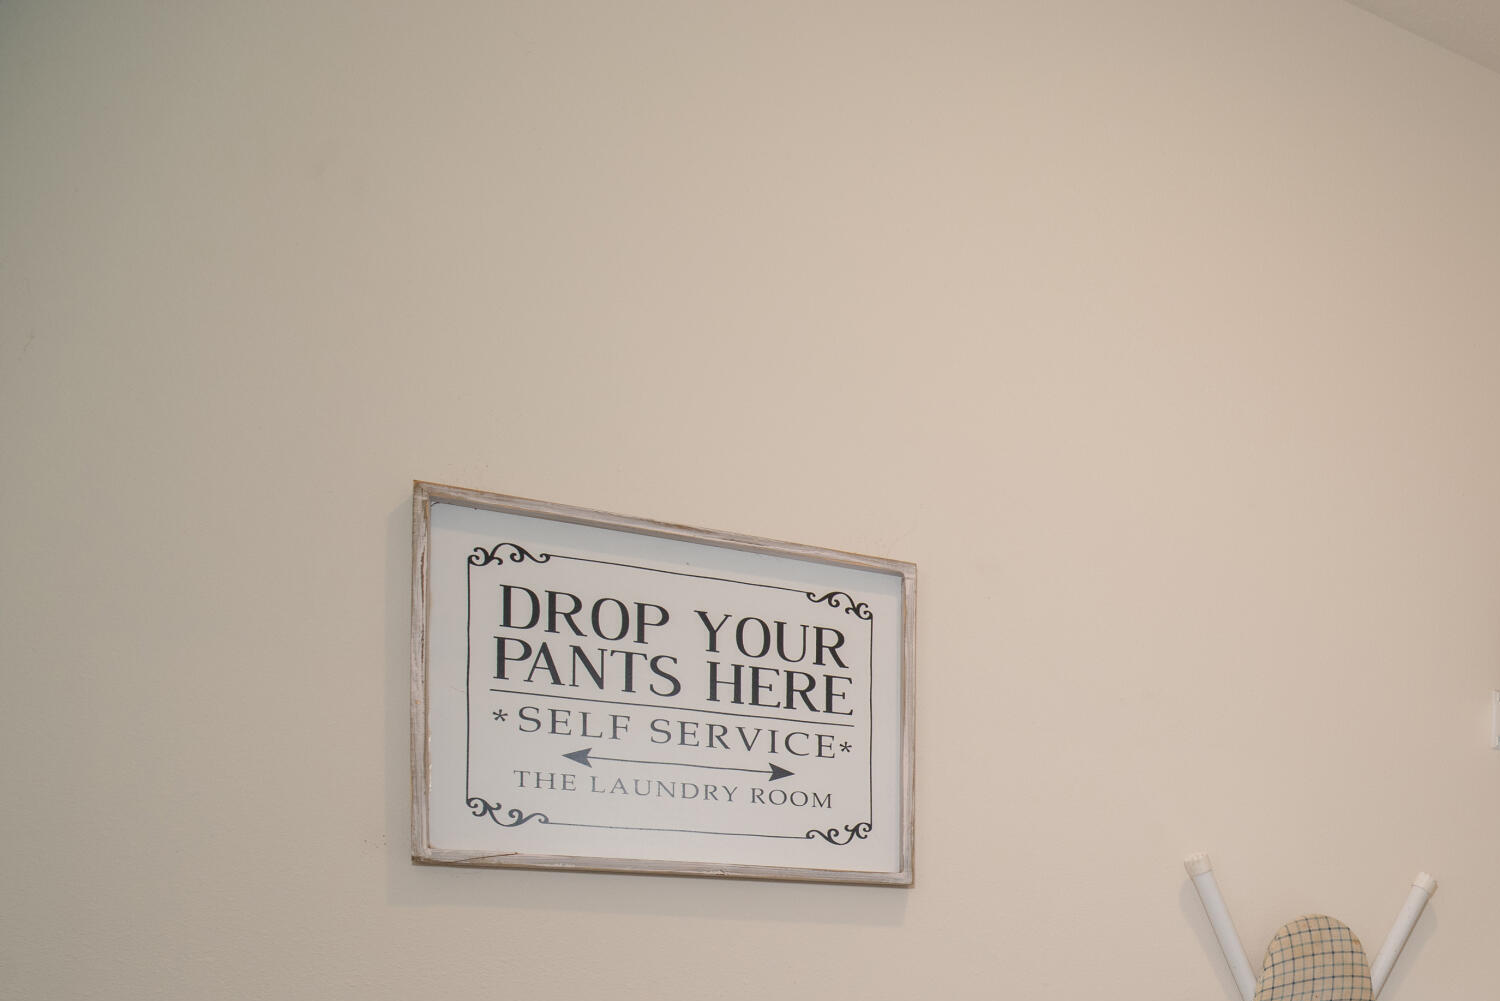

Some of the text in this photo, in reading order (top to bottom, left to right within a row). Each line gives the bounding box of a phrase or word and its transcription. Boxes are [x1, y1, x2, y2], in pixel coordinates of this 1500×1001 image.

[499, 584, 849, 669] DROP YOUR
[493, 635, 854, 716] PANTS HERE
[513, 769, 834, 809] THE LAUNDRY ROOM
